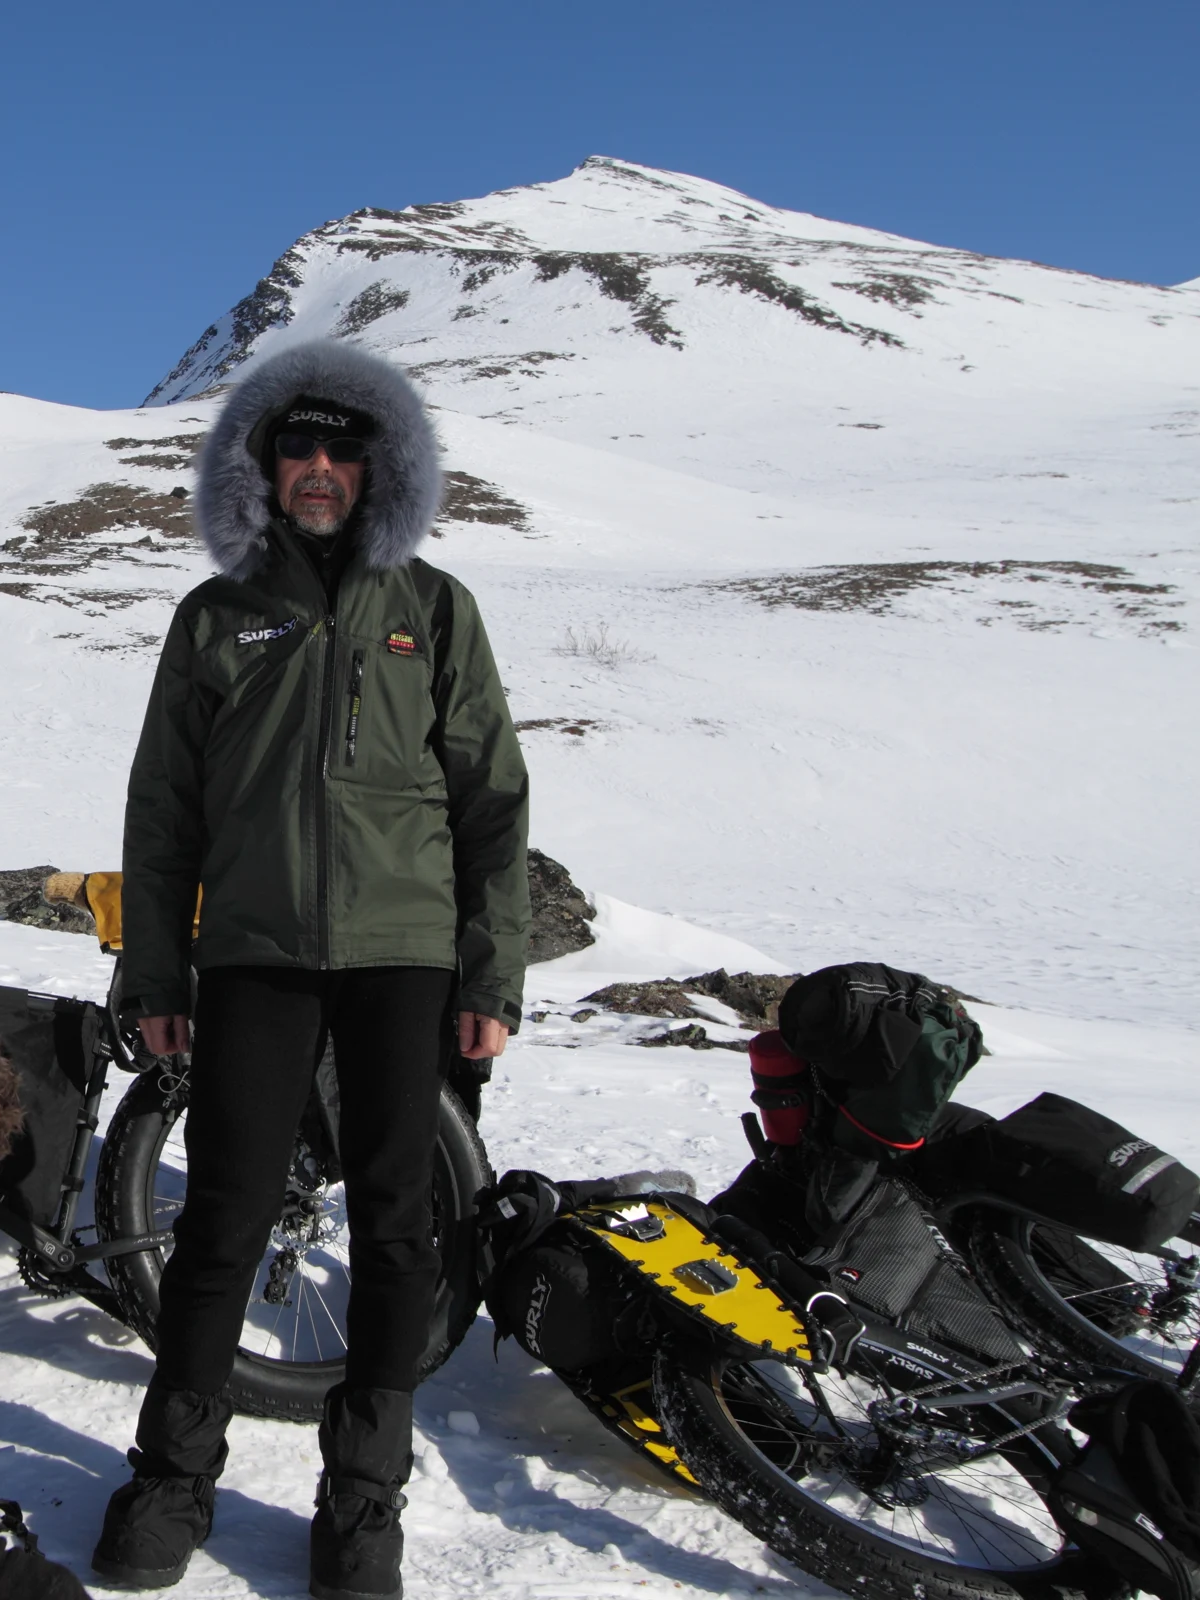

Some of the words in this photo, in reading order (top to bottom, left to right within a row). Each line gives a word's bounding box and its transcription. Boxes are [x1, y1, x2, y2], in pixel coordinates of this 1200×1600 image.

[287, 410, 350, 427] SURLY
[237, 617, 296, 644] SURLY
[525, 1276, 547, 1354] SURLY
[906, 1342, 950, 1363] SURLY
[888, 1354, 935, 1380] SURLY
